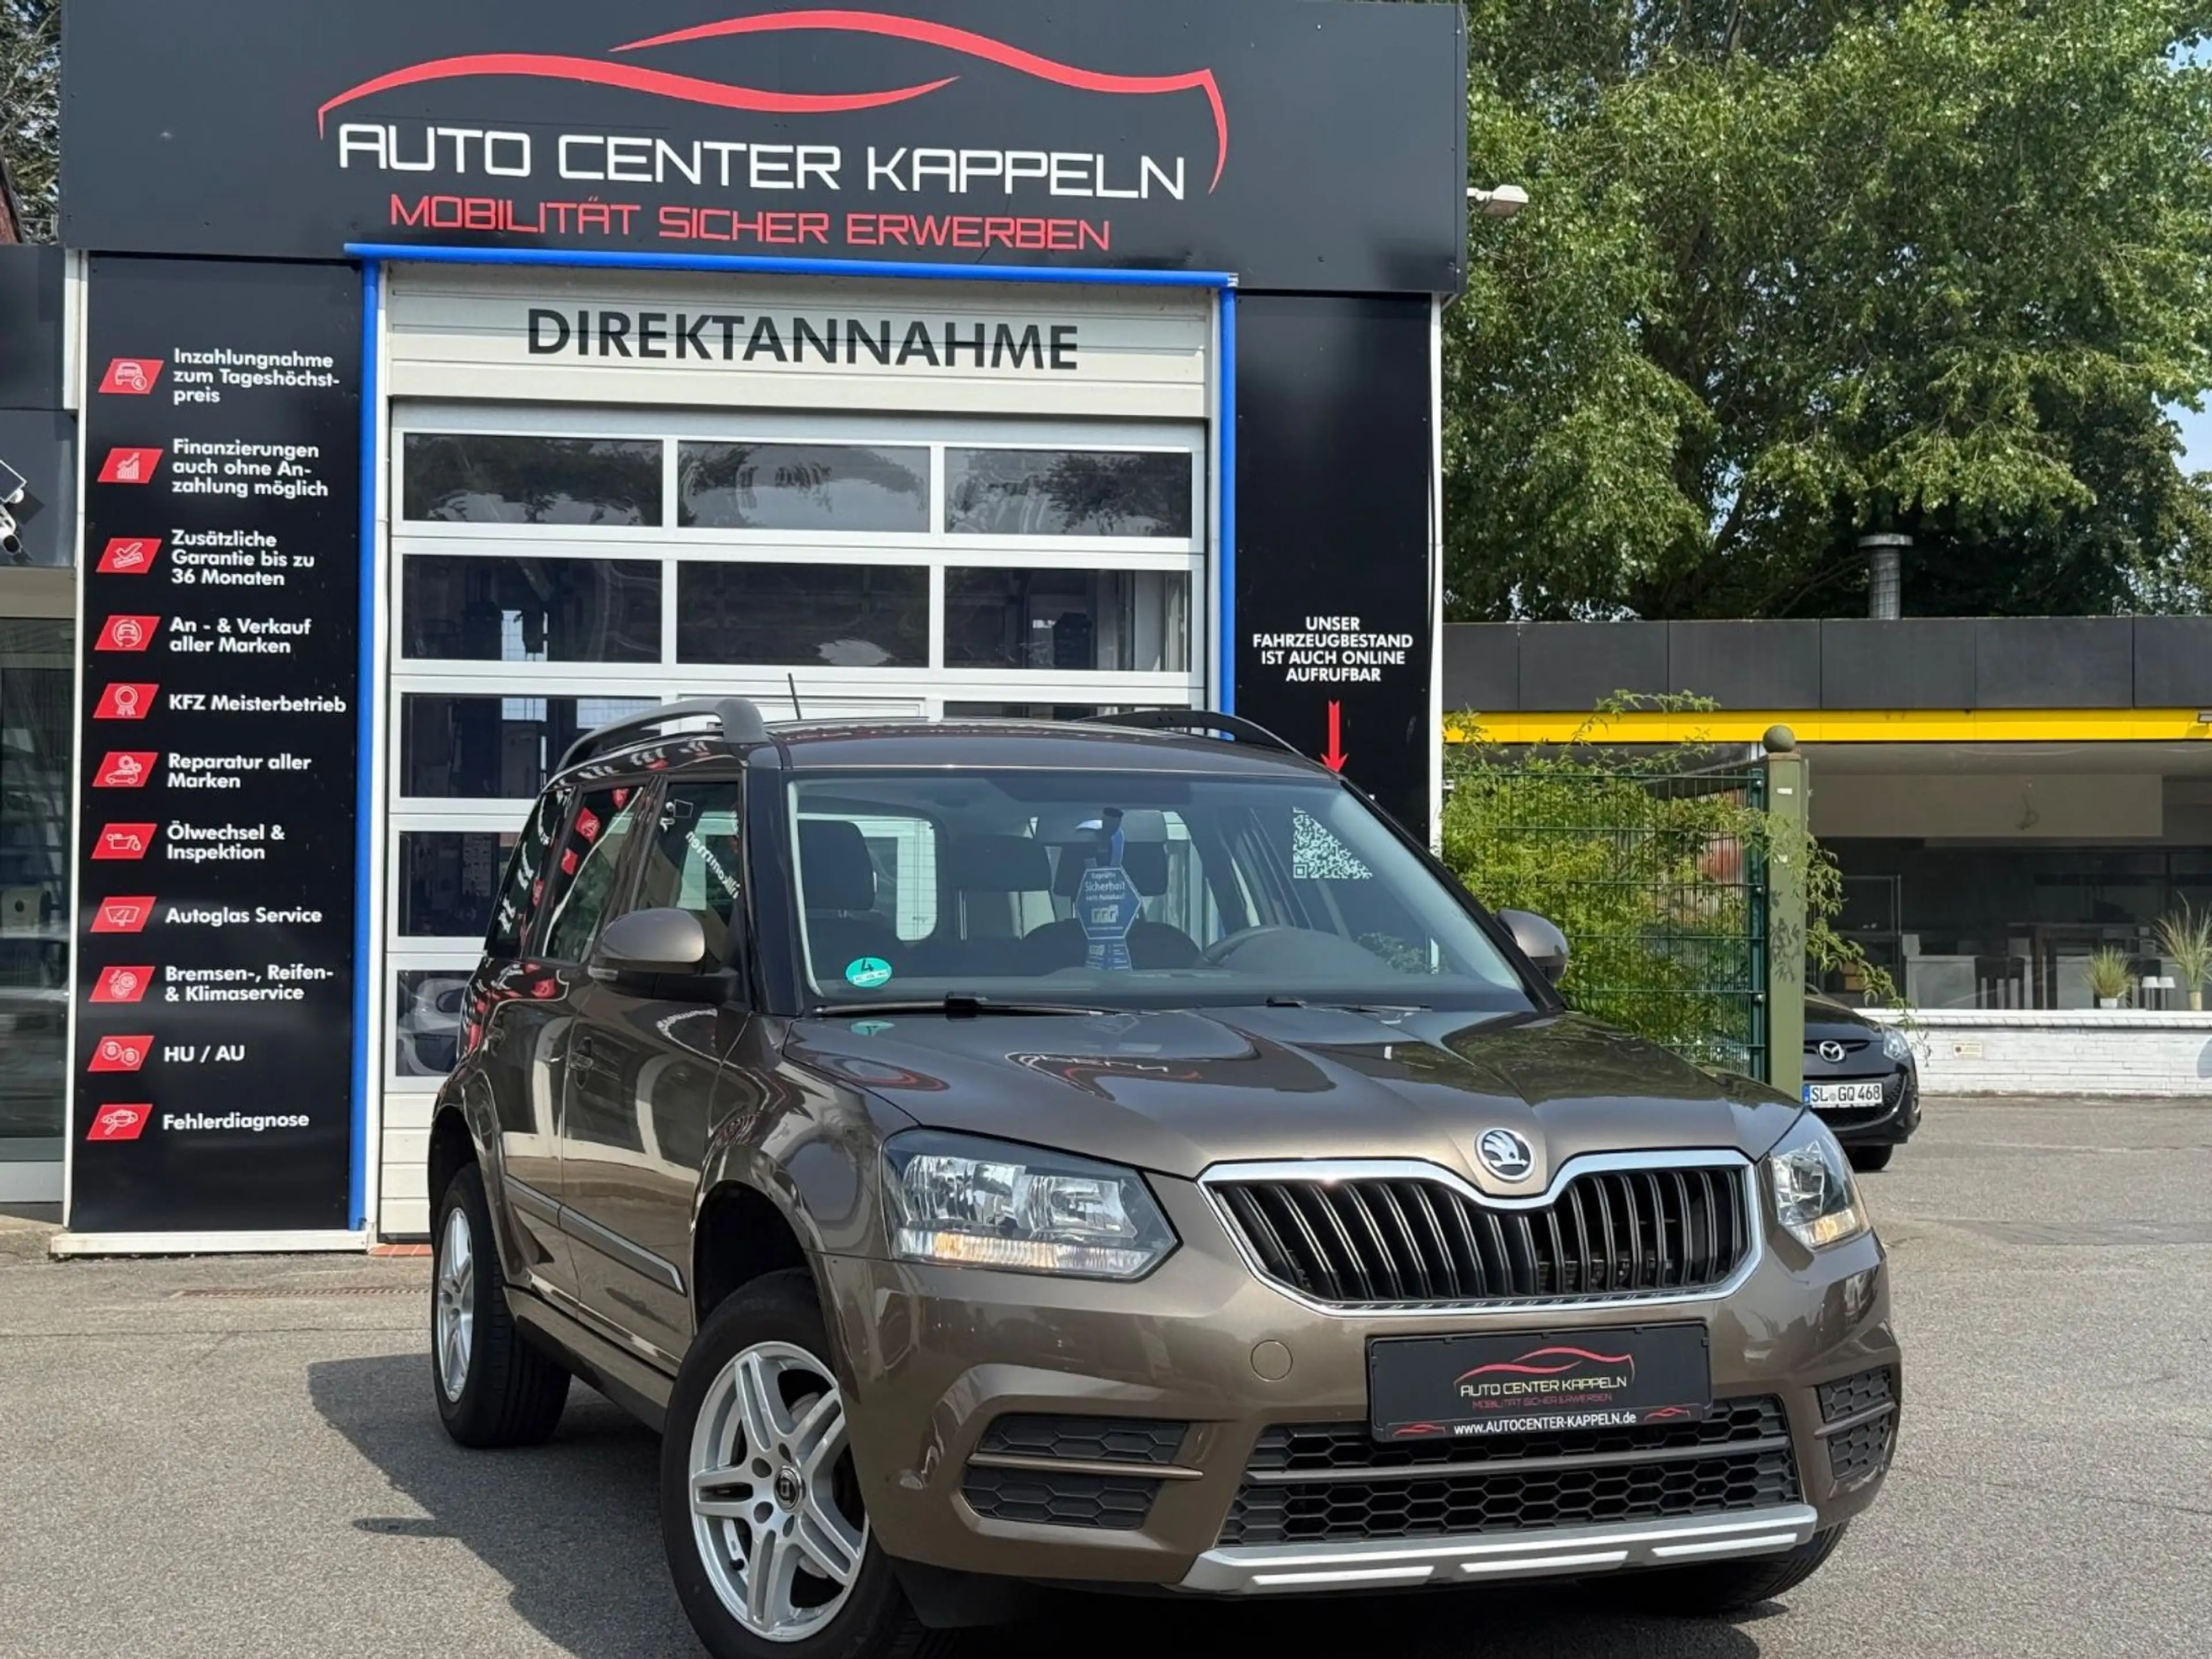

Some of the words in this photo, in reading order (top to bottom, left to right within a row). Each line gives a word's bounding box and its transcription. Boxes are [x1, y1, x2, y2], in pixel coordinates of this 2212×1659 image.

[339, 123, 531, 177] AUTO
[558, 134, 841, 190] CENTER
[867, 146, 1184, 200] KAPPELN
[391, 195, 641, 235] MOBILITÄT
[660, 207, 828, 242] SICHER
[847, 214, 1108, 248] ERWERBEN
[528, 309, 1078, 369] DIREKTANNAHME
[175, 347, 334, 369] Inzahlungnahme
[173, 371, 214, 383] zum
[219, 368, 340, 388] Tageshöchst-
[173, 387, 221, 406] preis
[173, 438, 319, 460] Finanzierungen
[172, 459, 218, 474] auch
[224, 459, 272, 476] ohne
[277, 461, 311, 476] An-
[172, 478, 248, 498] zahlung
[254, 481, 328, 499] möglich
[172, 529, 277, 547] Zusätzliche
[172, 548, 255, 566] Garantie
[261, 550, 287, 567] bis
[293, 556, 315, 567] zu
[172, 568, 195, 584] 36
[201, 570, 285, 586] Monaten
[169, 616, 196, 632] An
[217, 618, 231, 633] &
[237, 618, 312, 635] Verkauf
[1306, 616, 1360, 631] UNSER
[169, 637, 214, 652] aller
[218, 638, 291, 653] Marken
[1253, 633, 1413, 648] FAHRZEUGBESTAND
[1262, 650, 1285, 665] IST
[1289, 650, 1336, 665] AUCH
[1342, 650, 1405, 665] ONLINE
[1286, 667, 1381, 682] AUFRUFBAR
[169, 694, 206, 710] KFZ
[211, 695, 346, 713] Meisterbetrieb
[169, 753, 263, 772] Reparatur
[268, 753, 312, 770] aller
[168, 771, 240, 788] Marken
[167, 820, 264, 840] Ölwechsel
[271, 825, 285, 840] &
[168, 843, 265, 863] Inspektion
[165, 907, 250, 927] Autoglas
[255, 906, 322, 923] Service
[166, 966, 262, 983] Bremsen-,
[268, 963, 334, 980] Reifen-
[165, 986, 179, 1002] &
[185, 984, 305, 1002] Klimaservice
[164, 1046, 195, 1062] HU
[200, 1046, 211, 1063] /
[215, 1045, 245, 1061] AU
[1812, 1086, 1828, 1101] SL
[1838, 1086, 1854, 1101] GQ
[1858, 1085, 1880, 1100] 468
[163, 1112, 309, 1131] Fehlerdiagnose
[1461, 1384, 1500, 1397] AUTO
[1503, 1380, 1559, 1395] CENTER
[1562, 1376, 1627, 1390] KAPPELN
[1454, 1411, 1637, 1434] www.AUTOCENTER-KAPPELN.de
